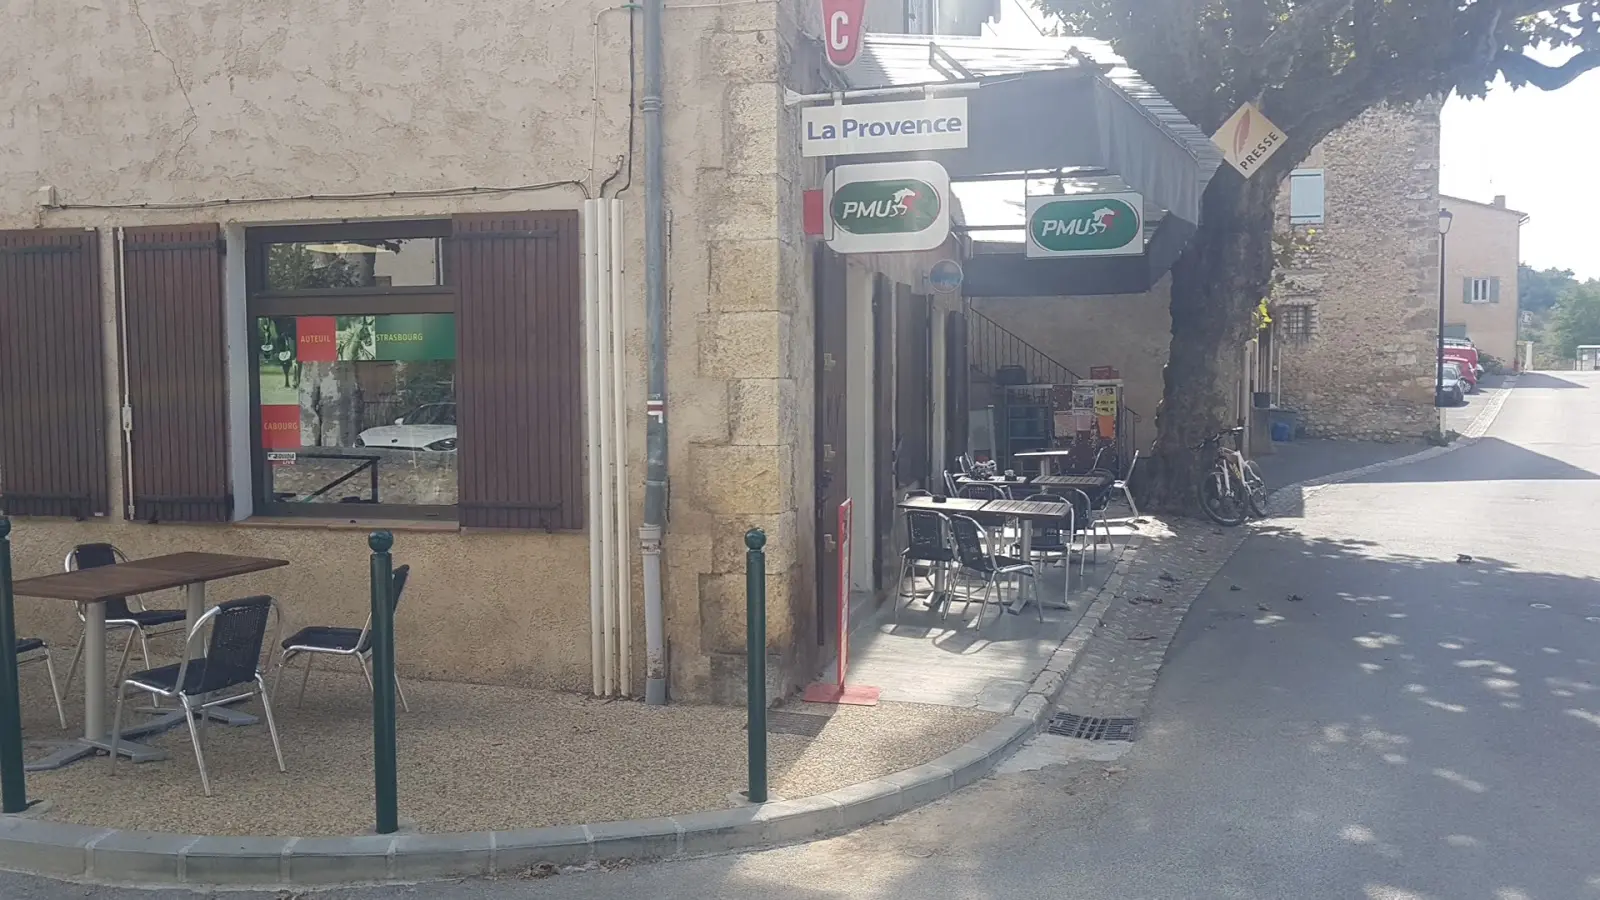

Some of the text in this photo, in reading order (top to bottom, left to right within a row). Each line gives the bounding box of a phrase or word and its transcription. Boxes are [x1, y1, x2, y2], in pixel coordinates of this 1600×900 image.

[831, 10, 849, 50] C
[807, 116, 963, 141] La Provence
[1239, 131, 1279, 171] PRESSE
[842, 199, 892, 219] PMU
[1041, 218, 1091, 237] PMU
[300, 335, 331, 344] AUTEUIL
[375, 333, 423, 342] STRASBOURG
[263, 422, 298, 431] CABOURG
